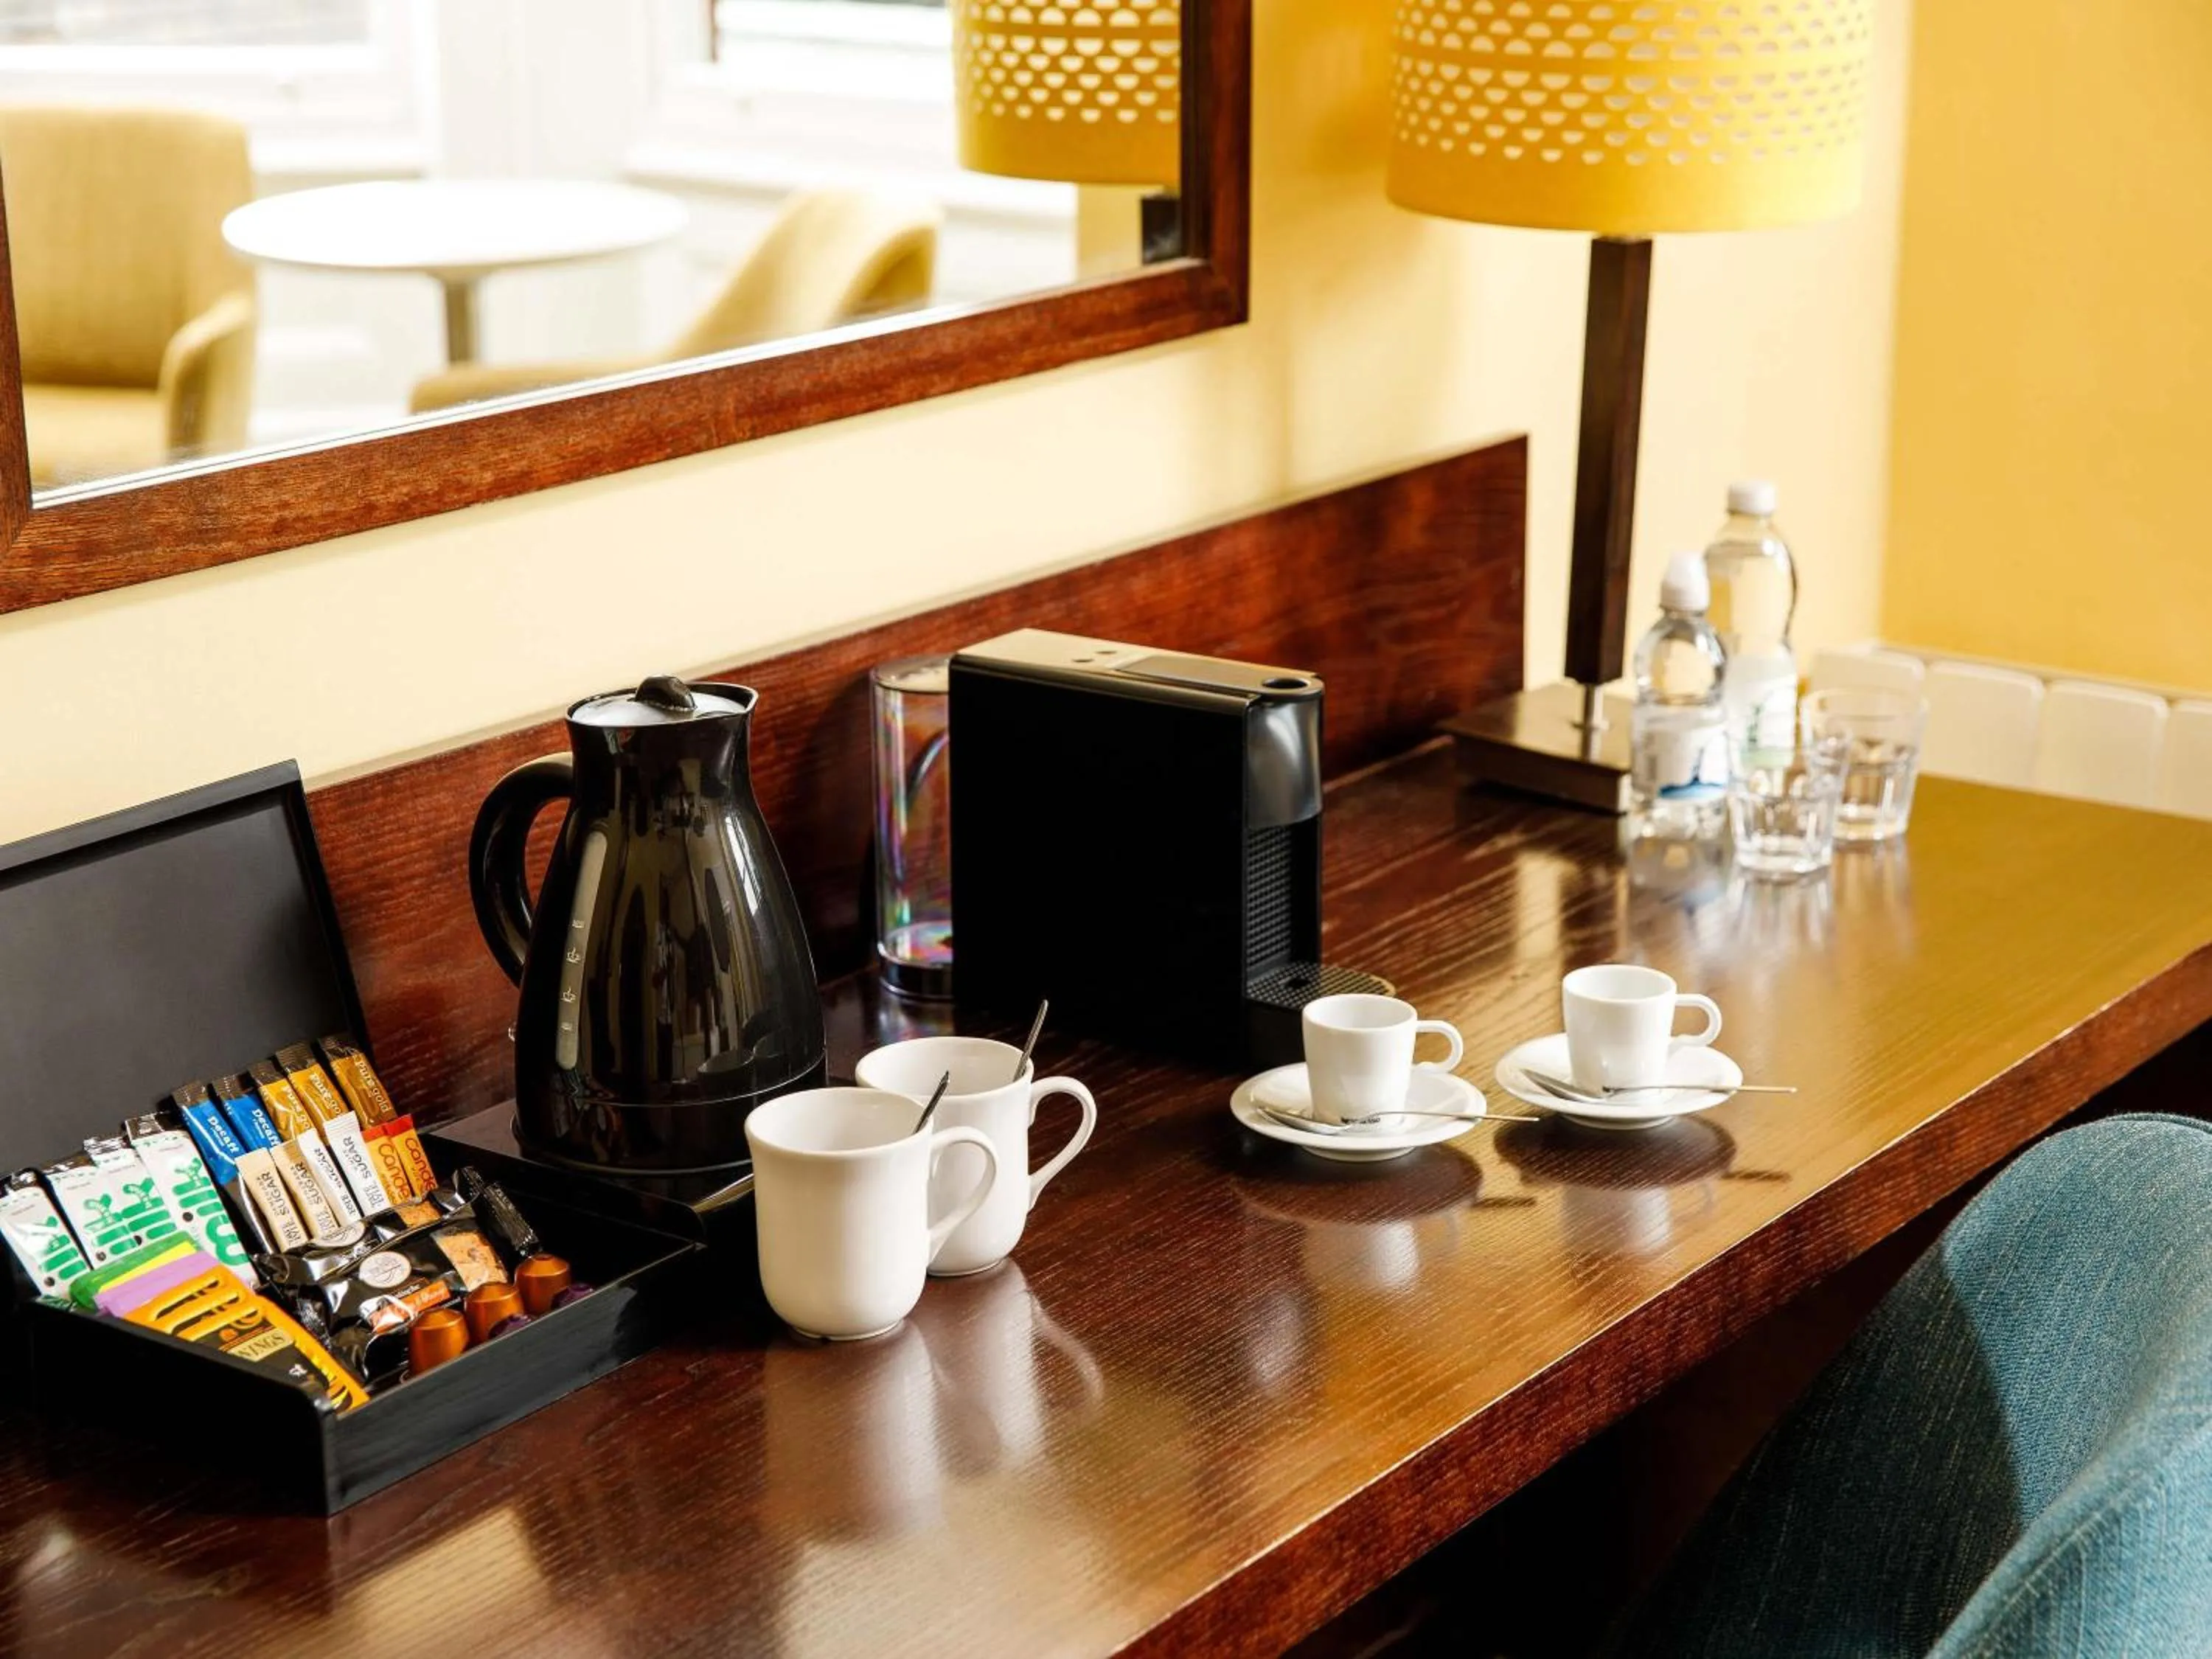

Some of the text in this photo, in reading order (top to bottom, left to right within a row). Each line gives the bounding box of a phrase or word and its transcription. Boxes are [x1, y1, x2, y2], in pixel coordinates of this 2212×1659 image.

[327, 1099, 342, 1116] go
[355, 1060, 392, 1114] Pure gold
[207, 1116, 240, 1153] Decaff
[252, 1109, 281, 1147] Decaff
[298, 1113, 313, 1130] go
[341, 1135, 372, 1180] SUGAR
[378, 1144, 408, 1197] Cande
[405, 1138, 436, 1191] Cande
[260, 1170, 291, 1217] SUGAR
[294, 1161, 323, 1206] SUGAR
[84, 1194, 137, 1261] ilk
[121, 1178, 177, 1245] ilk
[173, 1157, 251, 1265] milk
[37, 1216, 86, 1287] ilk
